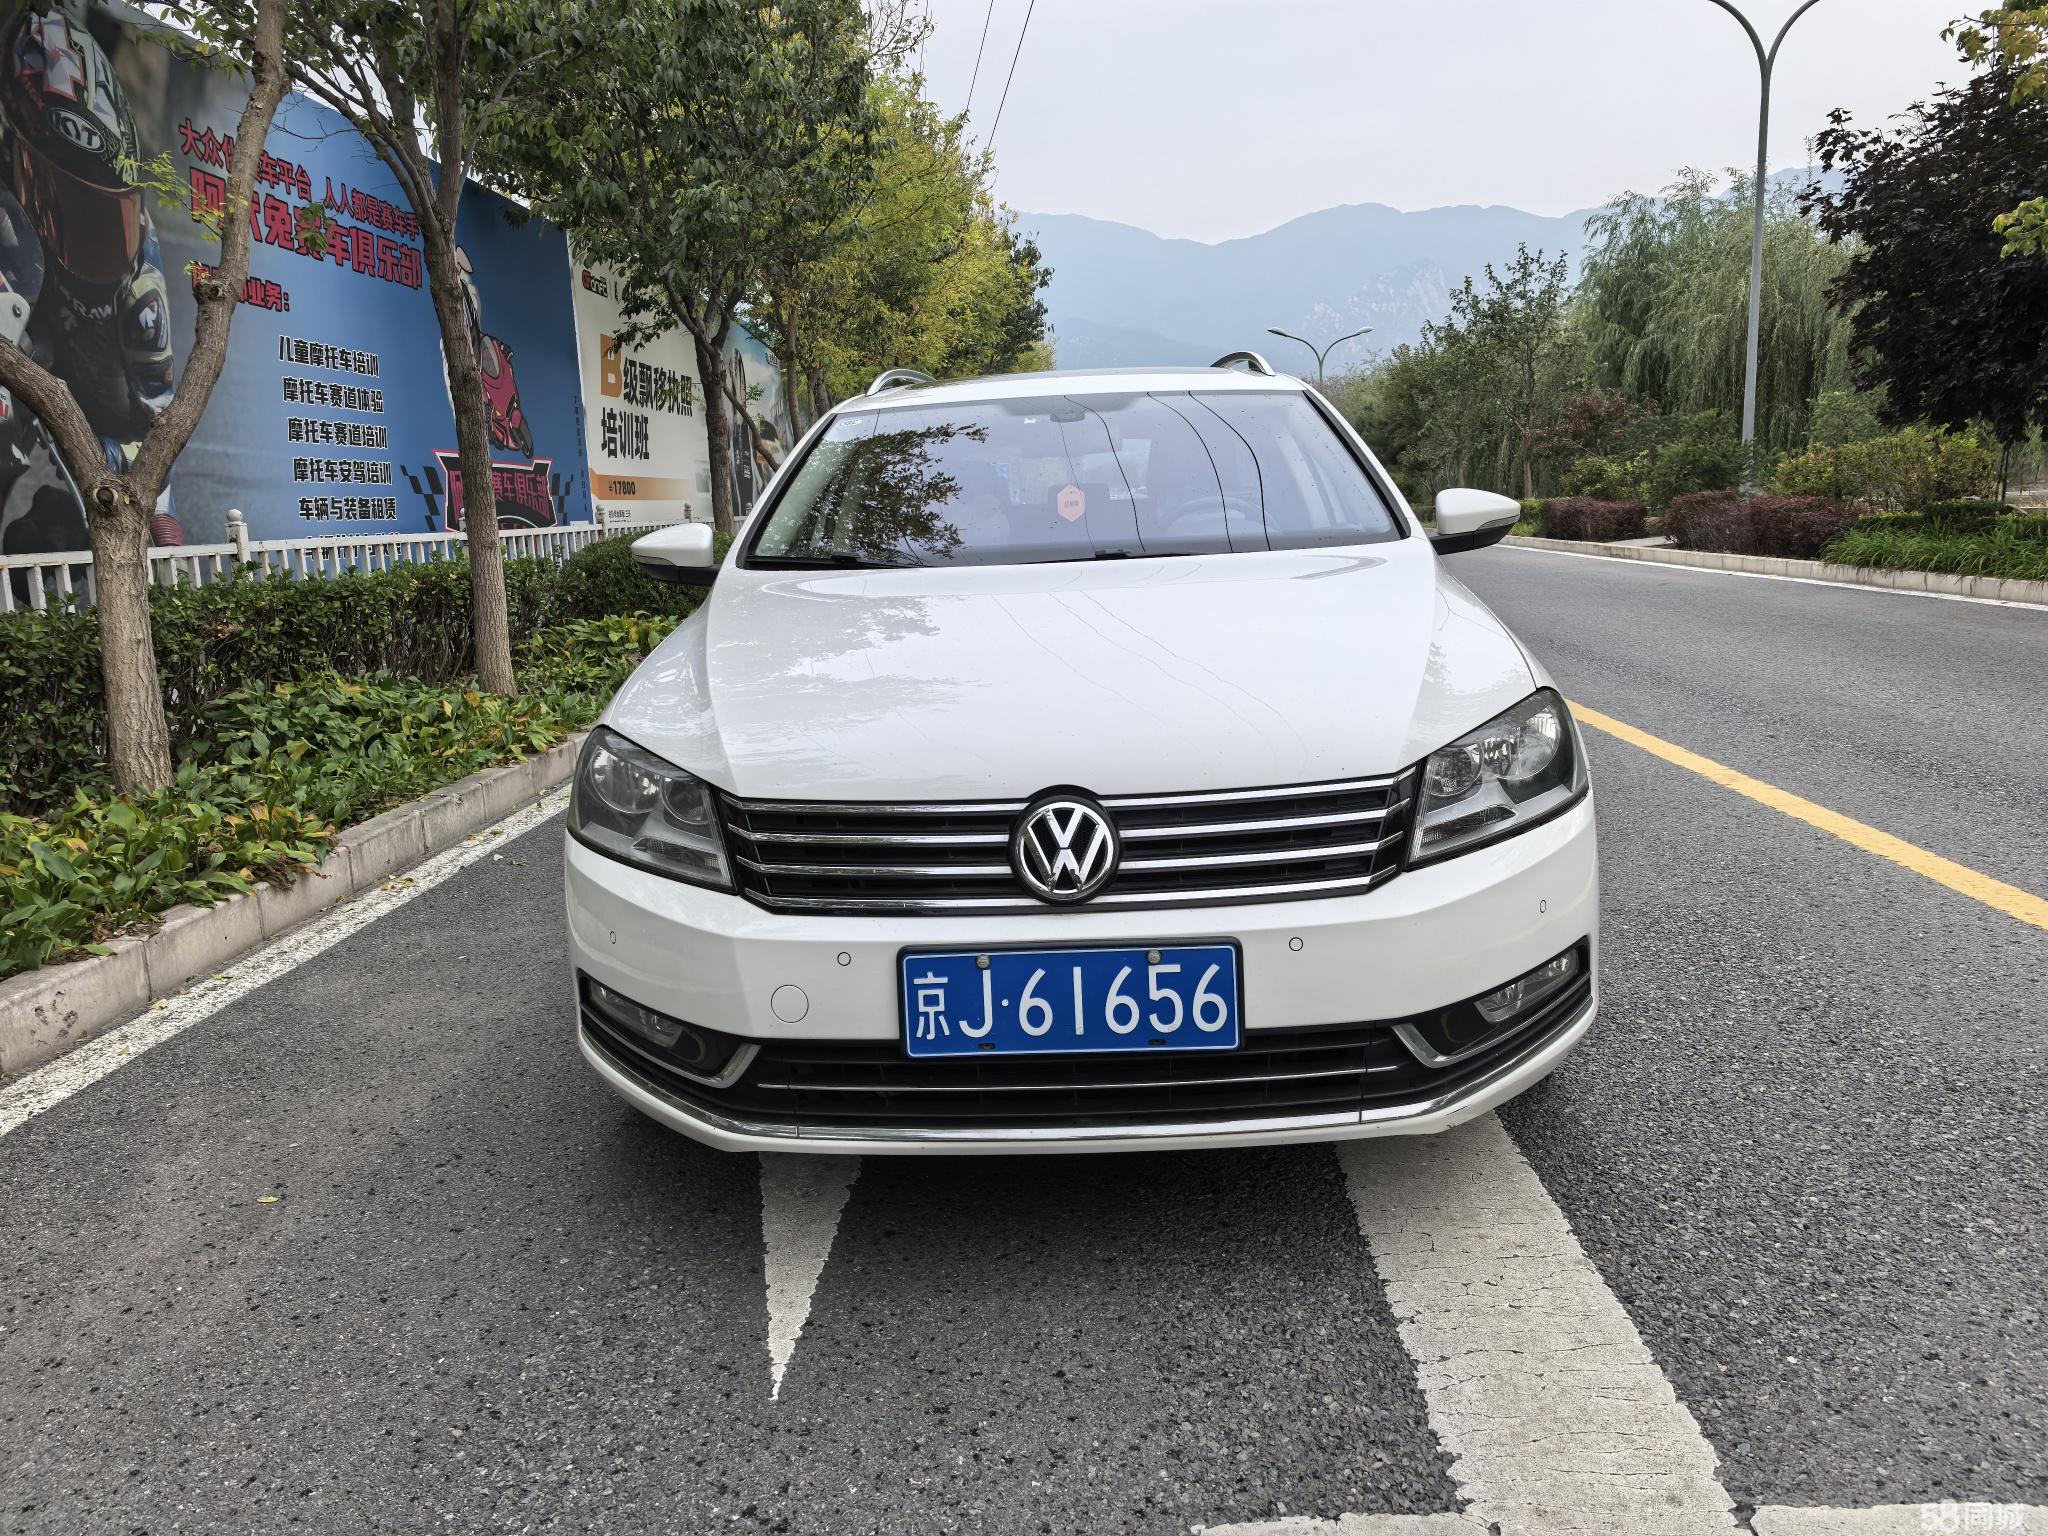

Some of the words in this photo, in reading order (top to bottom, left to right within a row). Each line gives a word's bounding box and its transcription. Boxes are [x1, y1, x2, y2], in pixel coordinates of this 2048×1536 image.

[178, 118, 312, 202] 大众车平台
[322, 177, 420, 241] 人人都是赛车手
[279, 335, 380, 378] 儿童摩托车培训
[282, 376, 384, 414] 摩托车赛道体验
[287, 417, 388, 449] 摩托车赛道培训
[601, 407, 650, 460] 培训班
[293, 456, 393, 485] 摩托车安驾培训
[298, 496, 398, 521] 车辆与装备租赁
